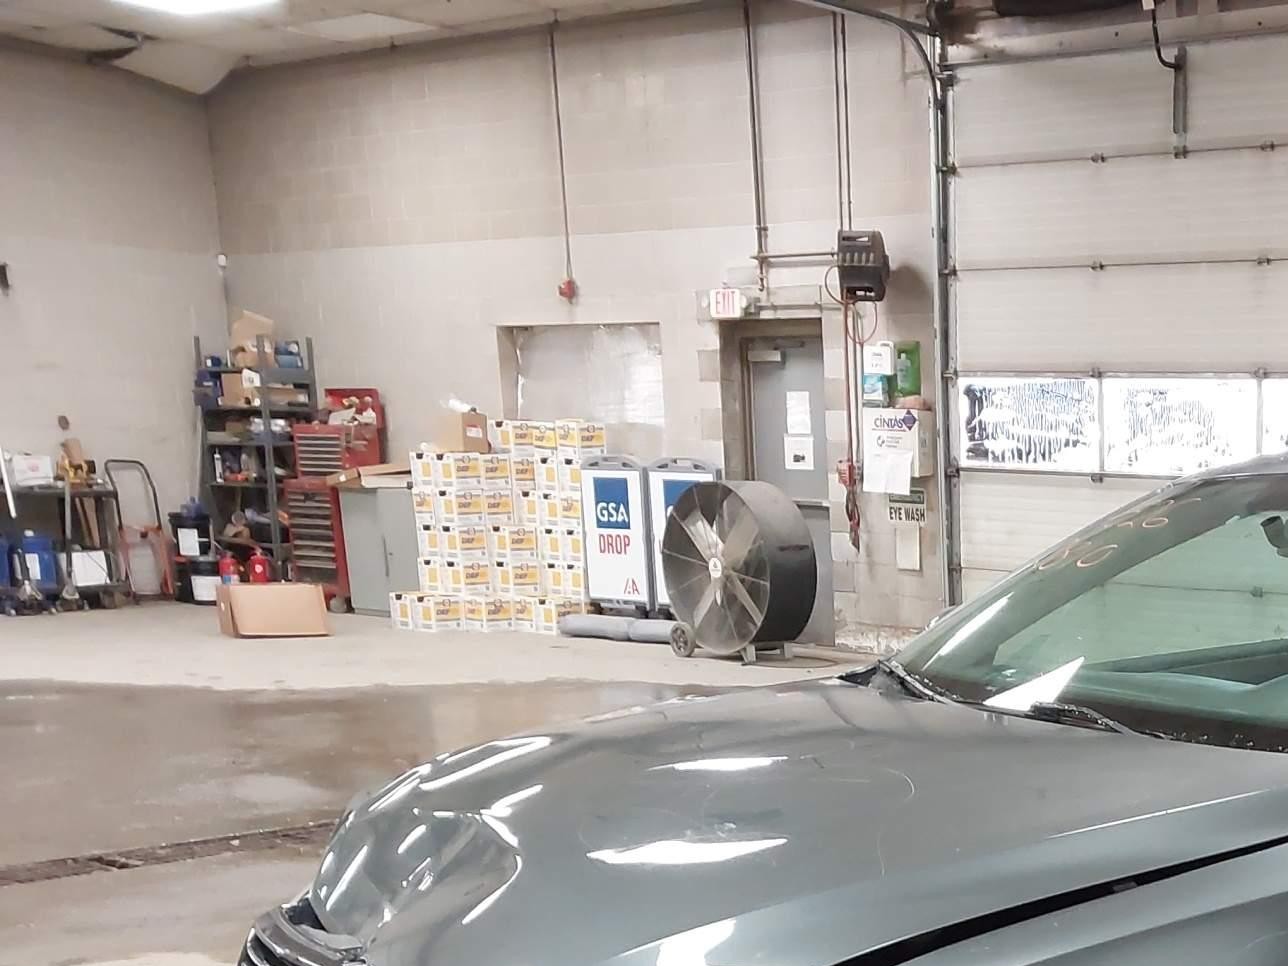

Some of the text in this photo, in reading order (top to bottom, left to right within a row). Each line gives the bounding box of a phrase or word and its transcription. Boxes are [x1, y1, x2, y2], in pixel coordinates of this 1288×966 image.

[715, 290, 736, 315] EXIT
[596, 502, 629, 523] GSA
[889, 506, 926, 522] EYE WASH
[598, 533, 631, 555] DROP
